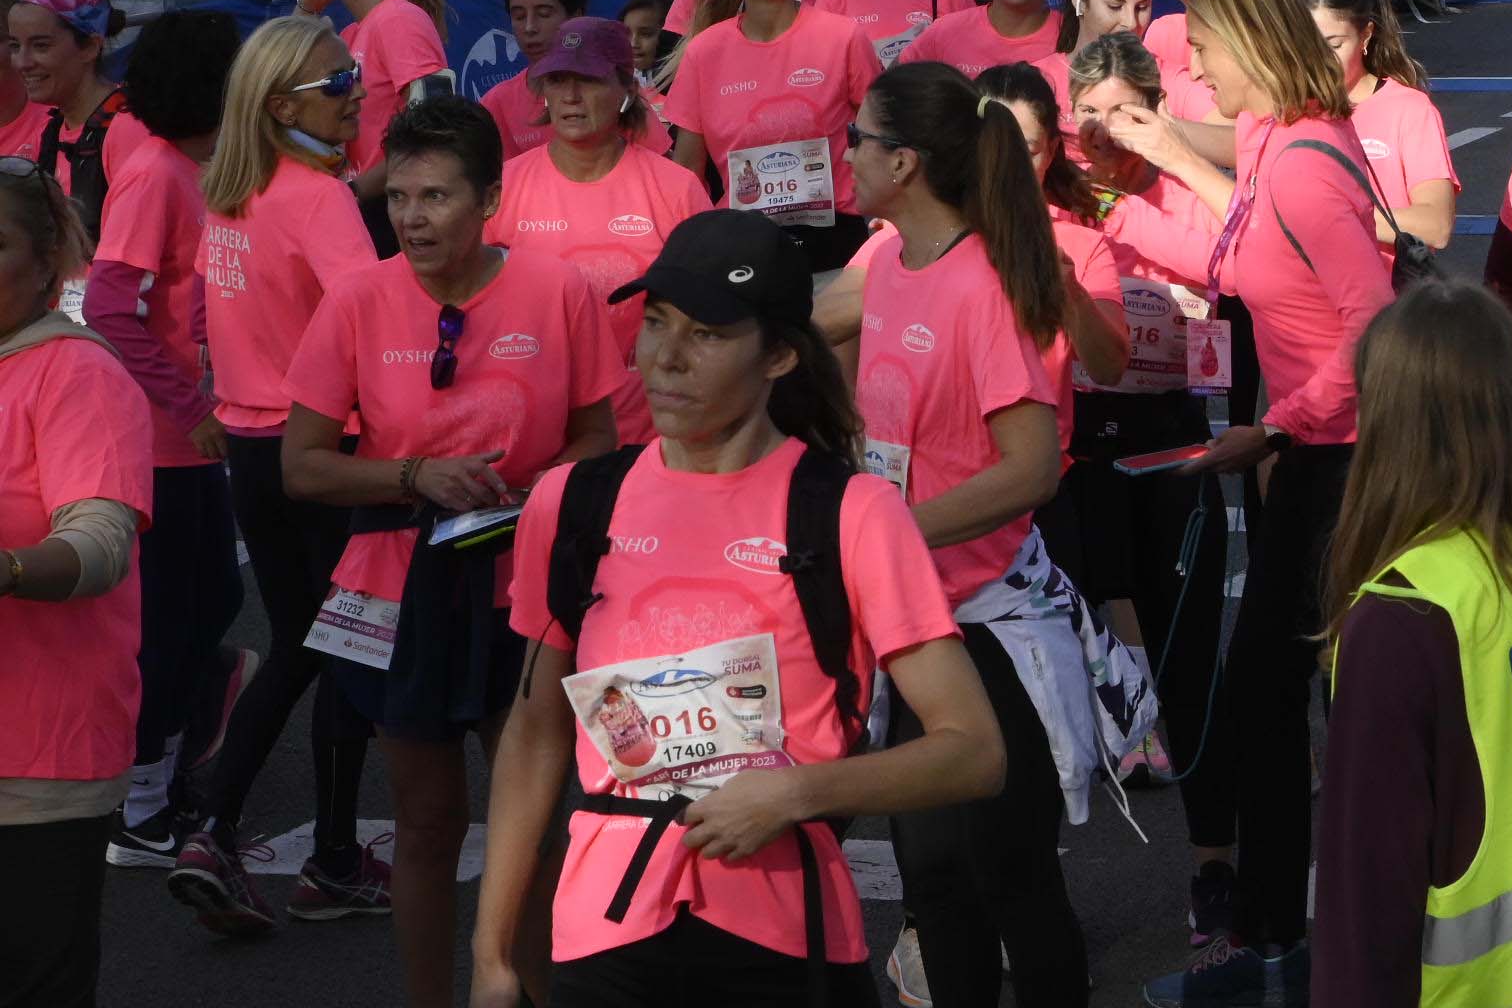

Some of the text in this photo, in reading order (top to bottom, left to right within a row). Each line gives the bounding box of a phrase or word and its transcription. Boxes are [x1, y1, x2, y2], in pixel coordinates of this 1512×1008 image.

[720, 80, 757, 96] OYSHO
[513, 131, 542, 144] YSHO
[764, 179, 797, 194] 016
[768, 195, 794, 205] 19475
[517, 219, 569, 233] OYSHO
[207, 223, 251, 254] ARRERA
[208, 245, 242, 271] DE LA
[207, 264, 247, 292] MUJER
[1128, 326, 1160, 342] 16
[492, 342, 539, 358] ASTURIANA
[611, 536, 659, 553] SHO
[730, 549, 780, 566] ASTURIA
[336, 599, 365, 617] 31232
[351, 622, 376, 633] MUJER
[724, 662, 763, 677] SUMA
[650, 706, 718, 739] 016
[663, 741, 717, 763] 17409
[672, 755, 777, 780] DE LA MUJER 2023
